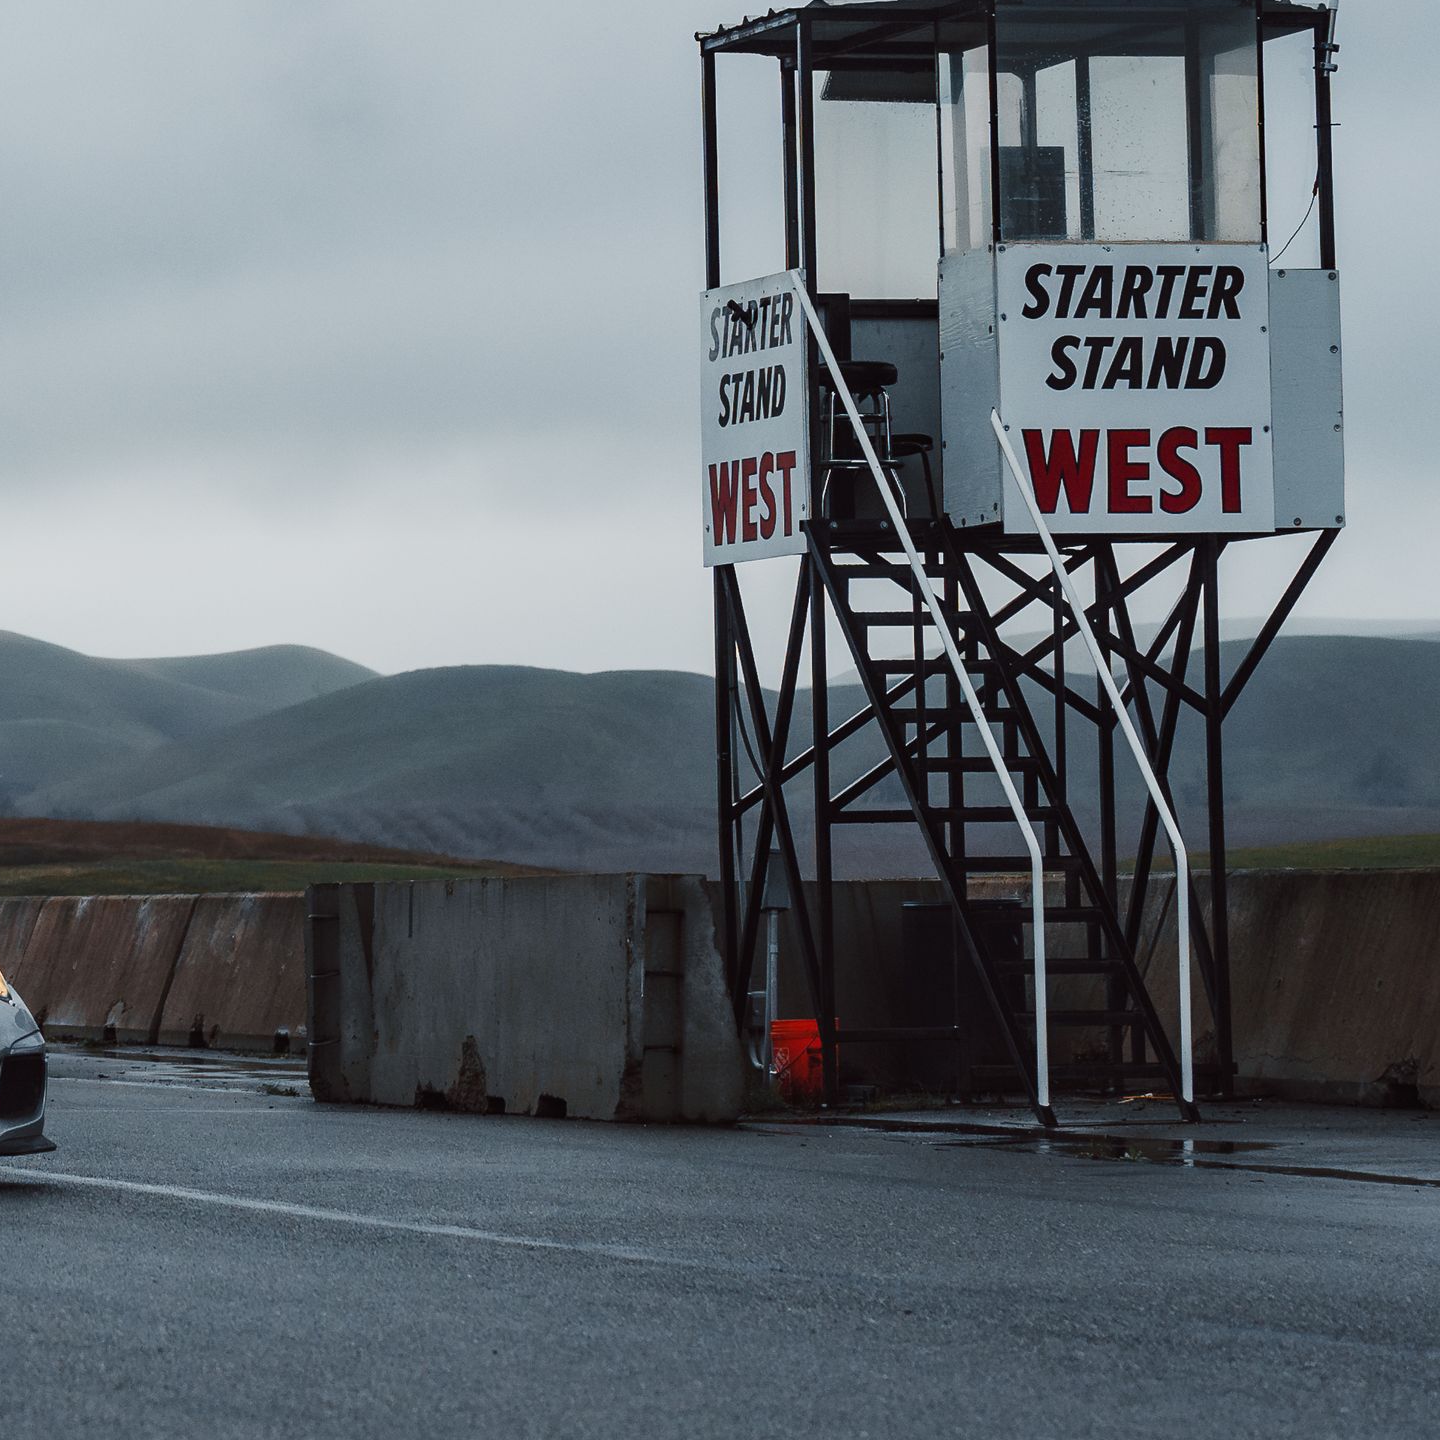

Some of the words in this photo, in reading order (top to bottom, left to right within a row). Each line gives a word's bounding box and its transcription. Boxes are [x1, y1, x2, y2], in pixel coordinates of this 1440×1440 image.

[1021, 263, 1245, 319] STARTER
[1045, 335, 1227, 390] STAND
[718, 364, 786, 428] STAND
[708, 450, 796, 547] WEST
[1021, 426, 1252, 514] WEST
